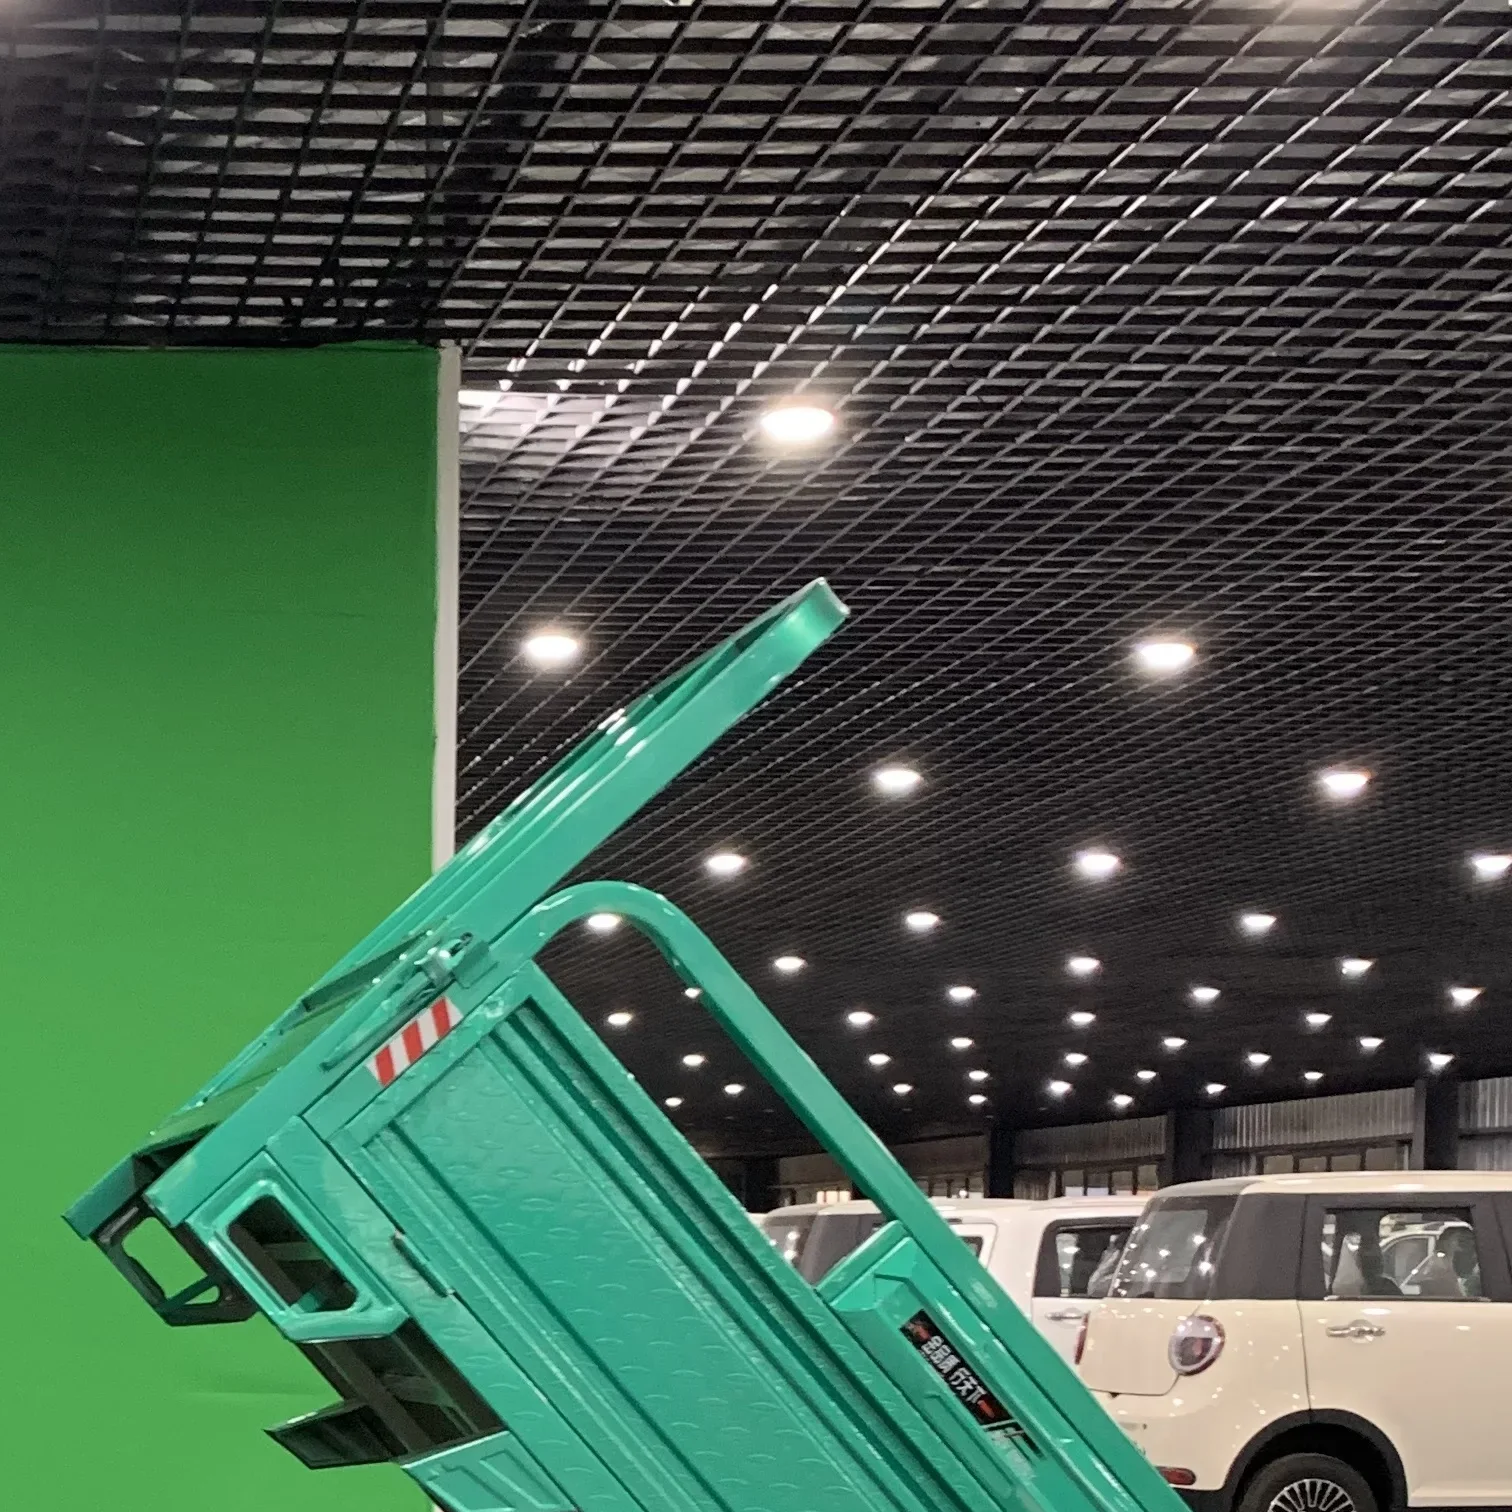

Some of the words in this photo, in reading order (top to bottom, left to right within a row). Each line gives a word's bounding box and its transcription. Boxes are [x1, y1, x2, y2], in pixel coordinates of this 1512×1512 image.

[922, 1335, 960, 1373] 金品质
[949, 1367, 986, 1403] 行天下
